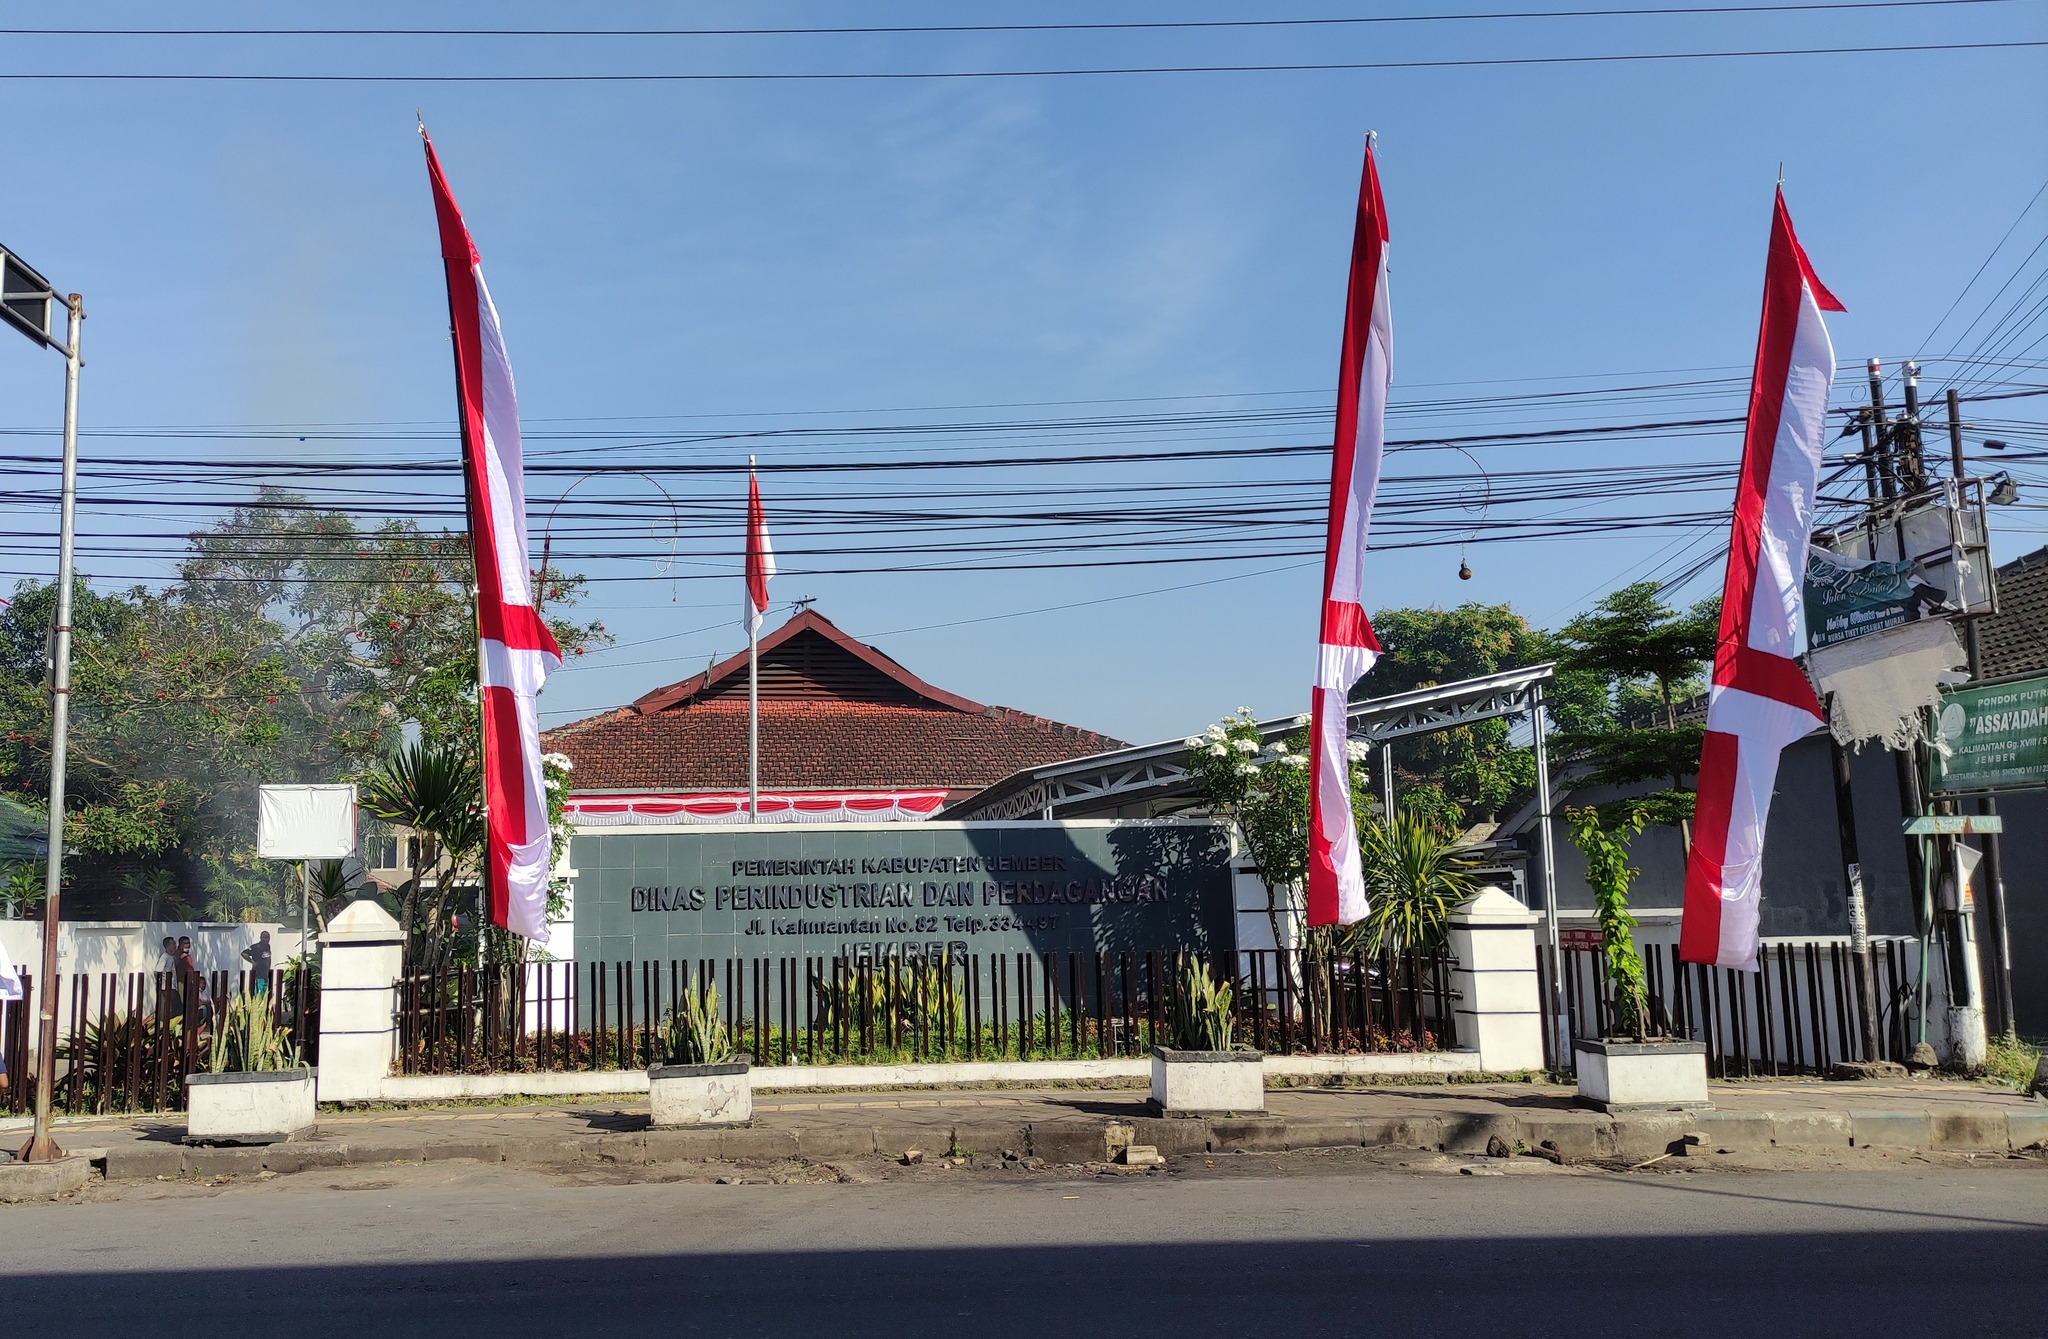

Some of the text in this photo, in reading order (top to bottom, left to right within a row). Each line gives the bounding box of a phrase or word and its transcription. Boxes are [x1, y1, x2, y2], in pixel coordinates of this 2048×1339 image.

[1845, 628, 1859, 639] TIKET
[1859, 621, 1884, 635] PESAWAT
[1977, 693, 2018, 707] PONDOK
[1959, 741, 2005, 754] KALIMANTAN
[1975, 753, 2016, 764] JEMBER
[732, 855, 1067, 876] PEMERINTAH KABUPATEN JEMBER
[631, 878, 1169, 912] DINAS PERINDUSTRIAN DAN PERDAGANGAN
[771, 917, 880, 936] Kalimantan
